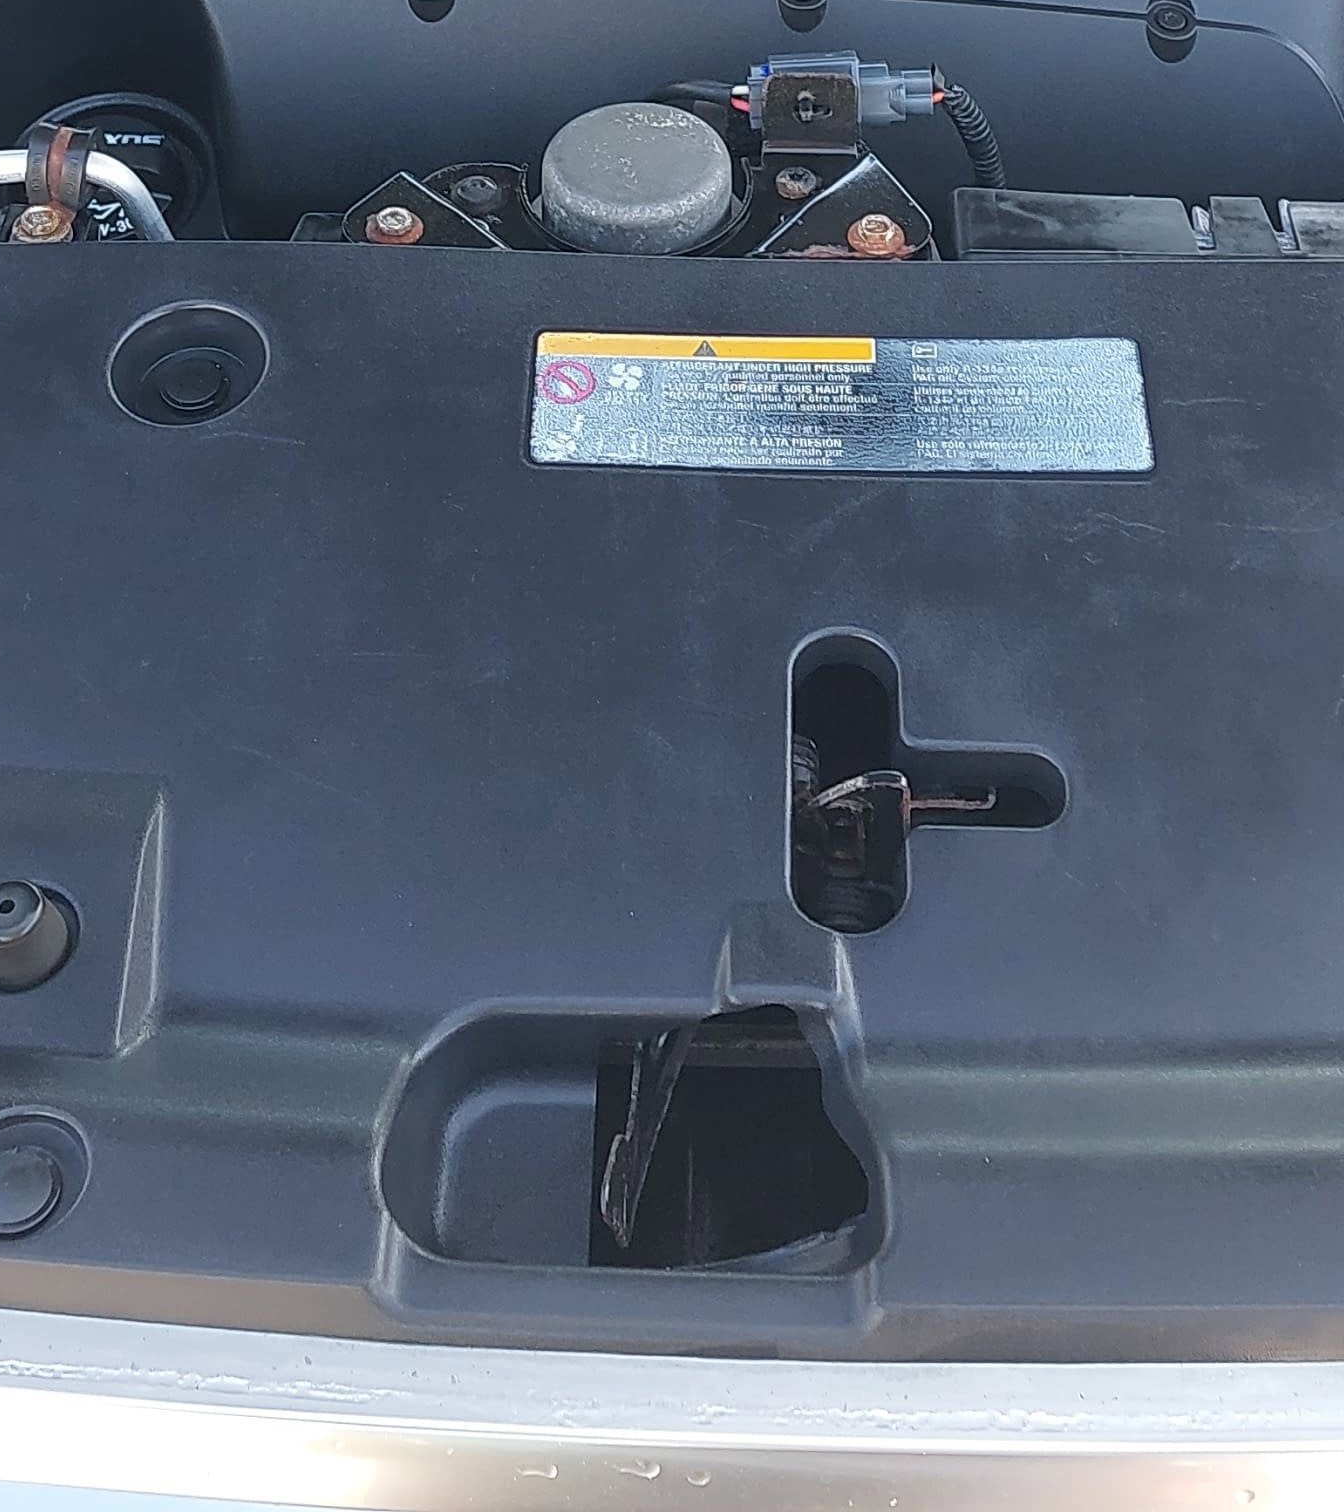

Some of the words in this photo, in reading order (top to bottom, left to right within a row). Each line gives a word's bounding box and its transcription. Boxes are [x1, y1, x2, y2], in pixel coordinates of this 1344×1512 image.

[814, 364, 874, 374] PRESSURE
[782, 384, 813, 394] SOUS
[815, 384, 853, 394] HAUTE
[761, 437, 789, 447] ALTA
